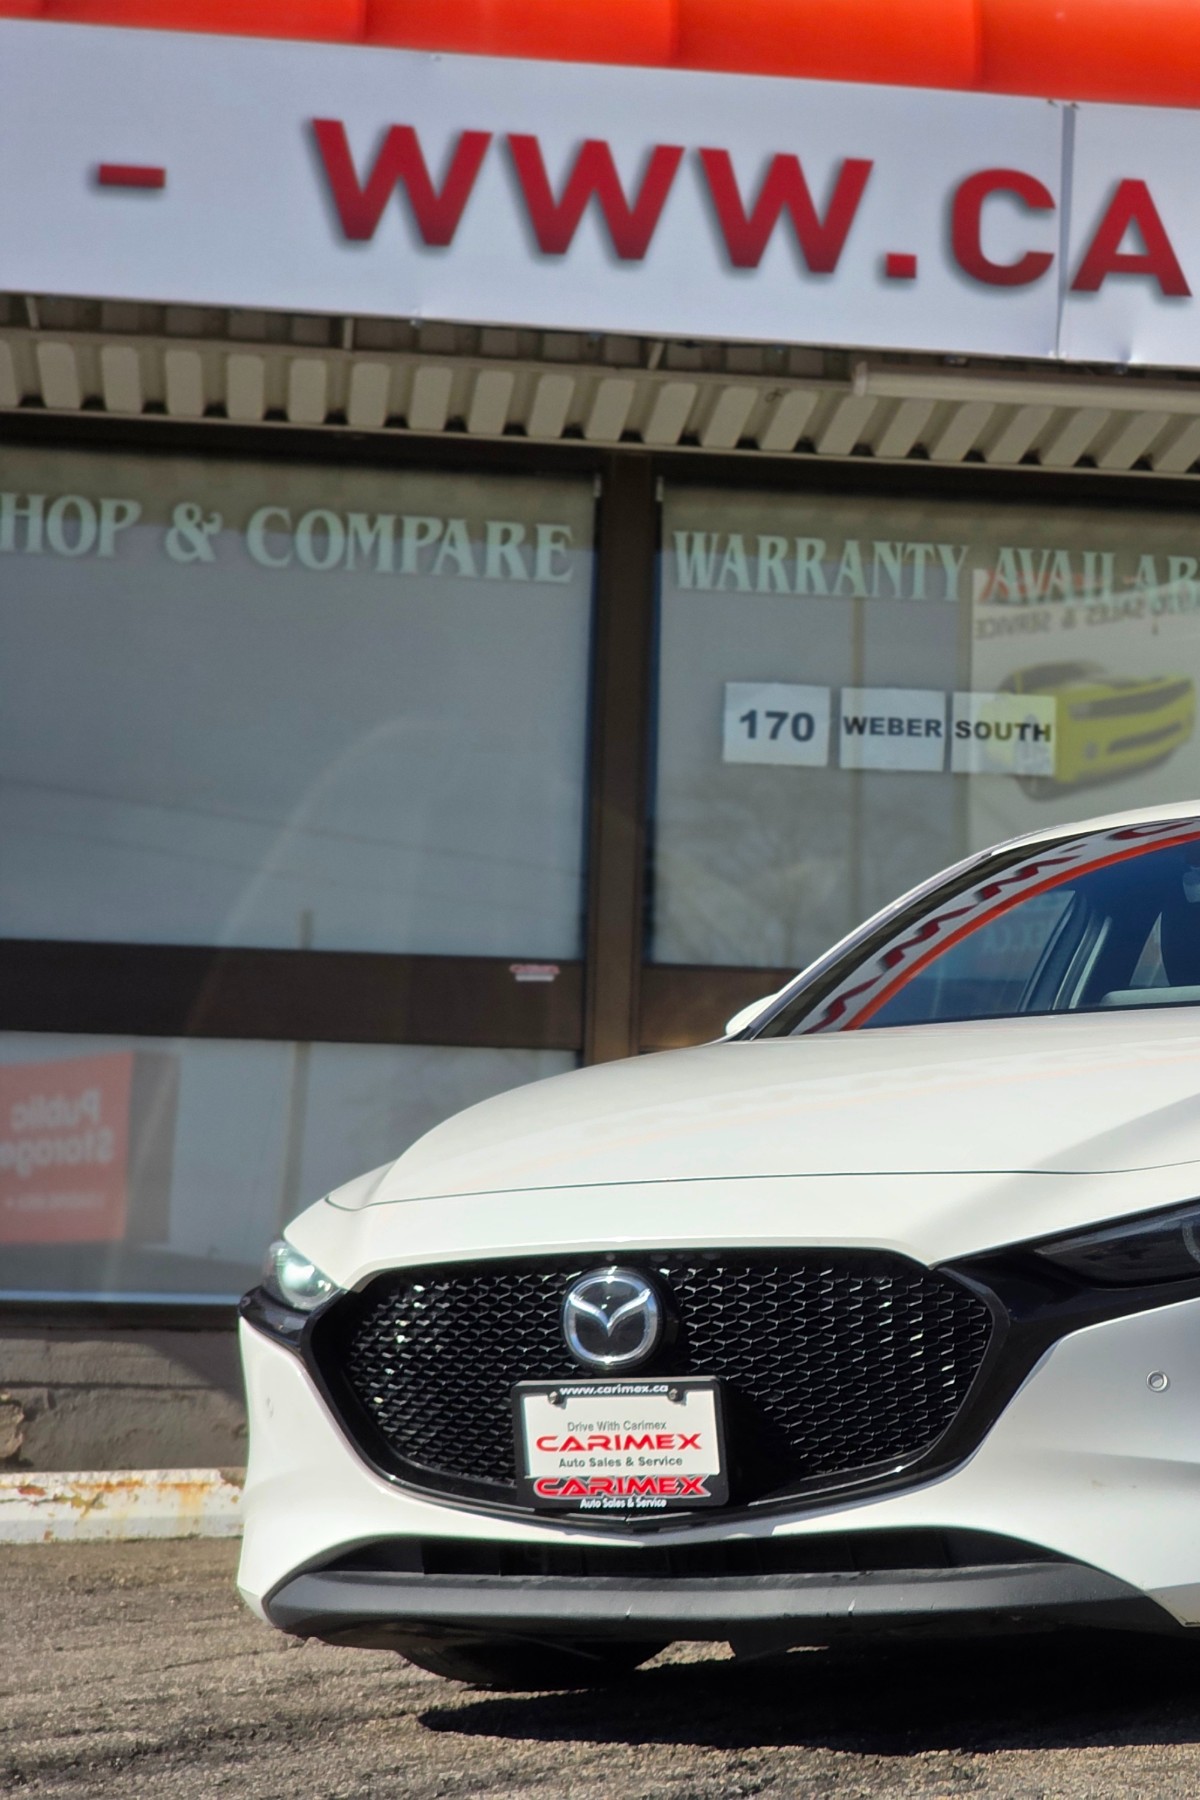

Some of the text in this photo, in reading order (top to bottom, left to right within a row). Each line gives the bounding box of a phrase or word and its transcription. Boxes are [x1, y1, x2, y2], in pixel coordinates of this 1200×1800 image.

[165, 502, 223, 564] &
[246, 506, 576, 584] COMPARE
[673, 530, 970, 600] WARRANTY
[738, 709, 1052, 743] 170 WEBER SOUTH
[559, 1384, 669, 1395] www.carimex.ca
[567, 1420, 667, 1432] Drive With Carimex
[536, 1433, 702, 1452] CARIMEX
[559, 1456, 683, 1468] Auto Sales & Service
[535, 1475, 710, 1498] CARIMEX
[580, 1498, 601, 1509] Auto
[602, 1498, 625, 1509] Sales
[636, 1498, 667, 1508] Service
